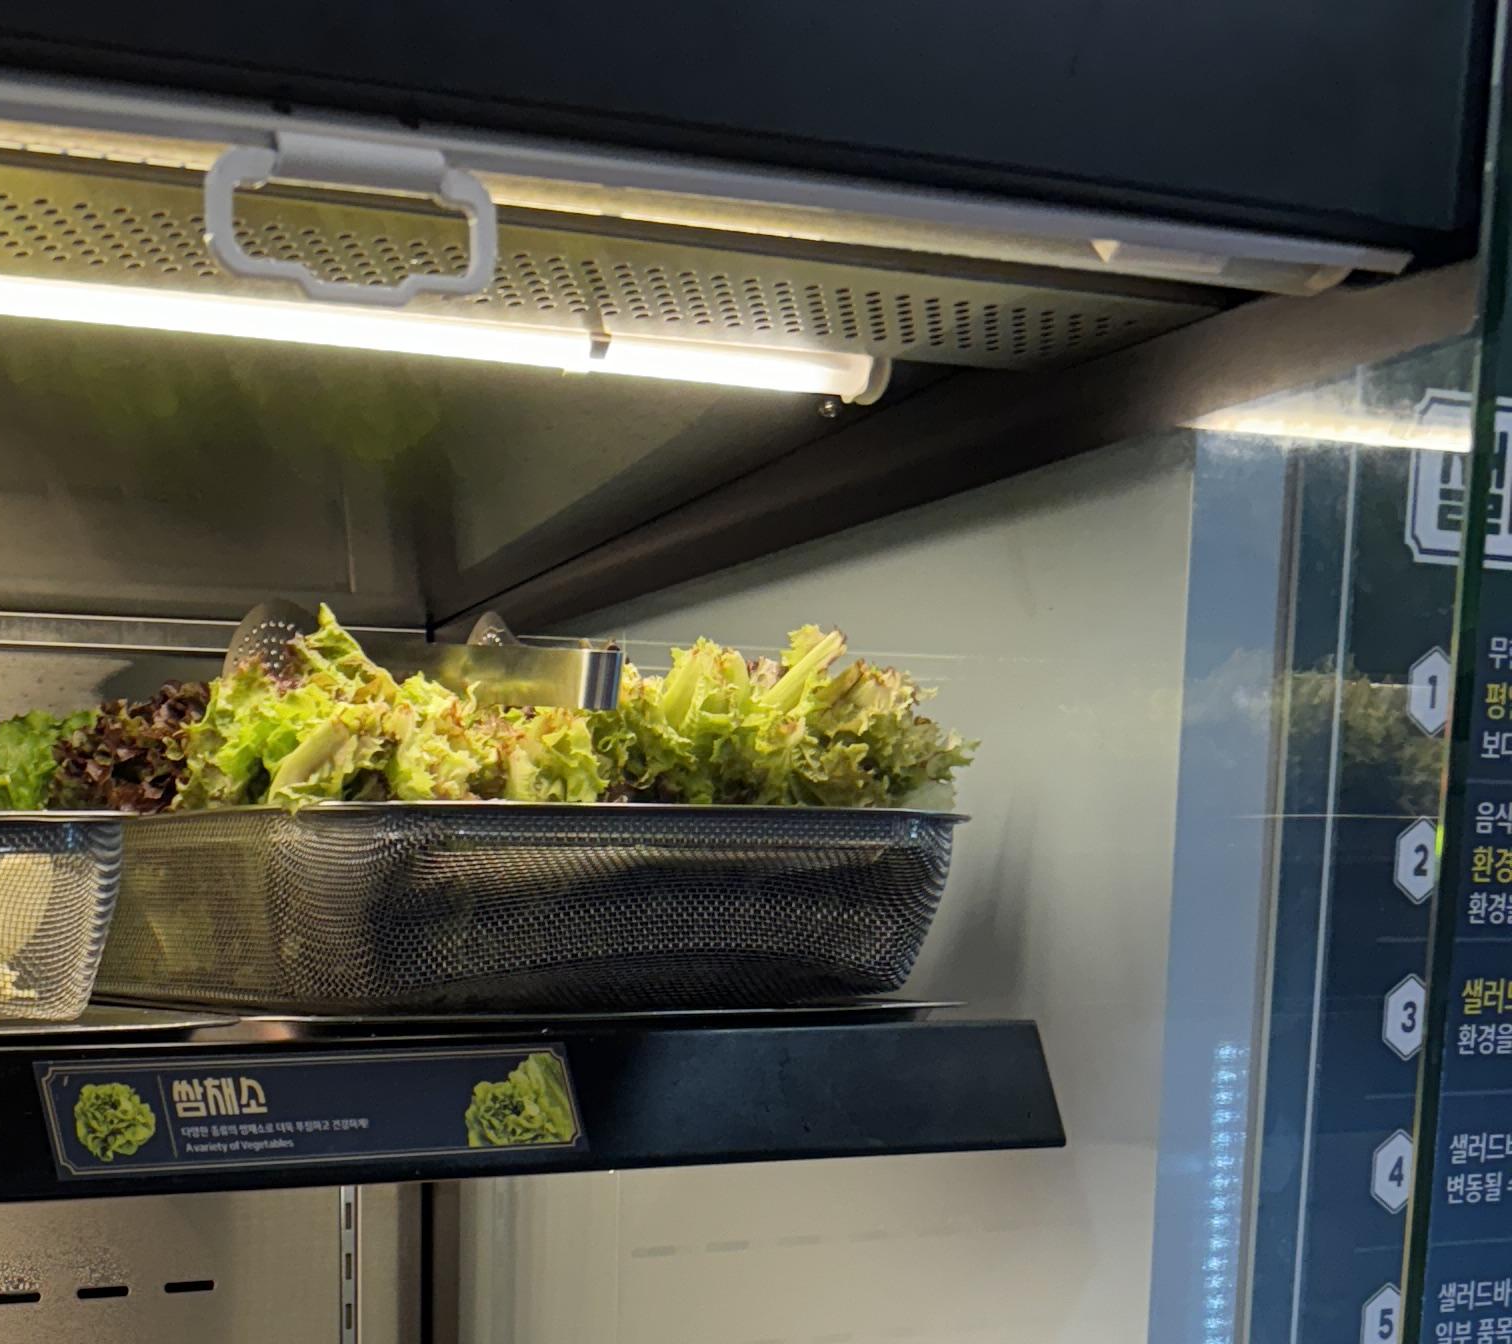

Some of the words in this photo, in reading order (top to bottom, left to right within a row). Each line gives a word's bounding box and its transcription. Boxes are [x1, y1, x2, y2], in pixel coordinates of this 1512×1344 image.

[1428, 675, 1437, 709] 1
[1413, 844, 1428, 877] 2
[1401, 1000, 1417, 1034] 3
[172, 1076, 268, 1118] 쌈채소
[242, 1138, 294, 1151] Vegetables
[1388, 1156, 1404, 1188] 4
[1447, 1172, 1502, 1205] 변동될
[1379, 1308, 1394, 1340] 5
